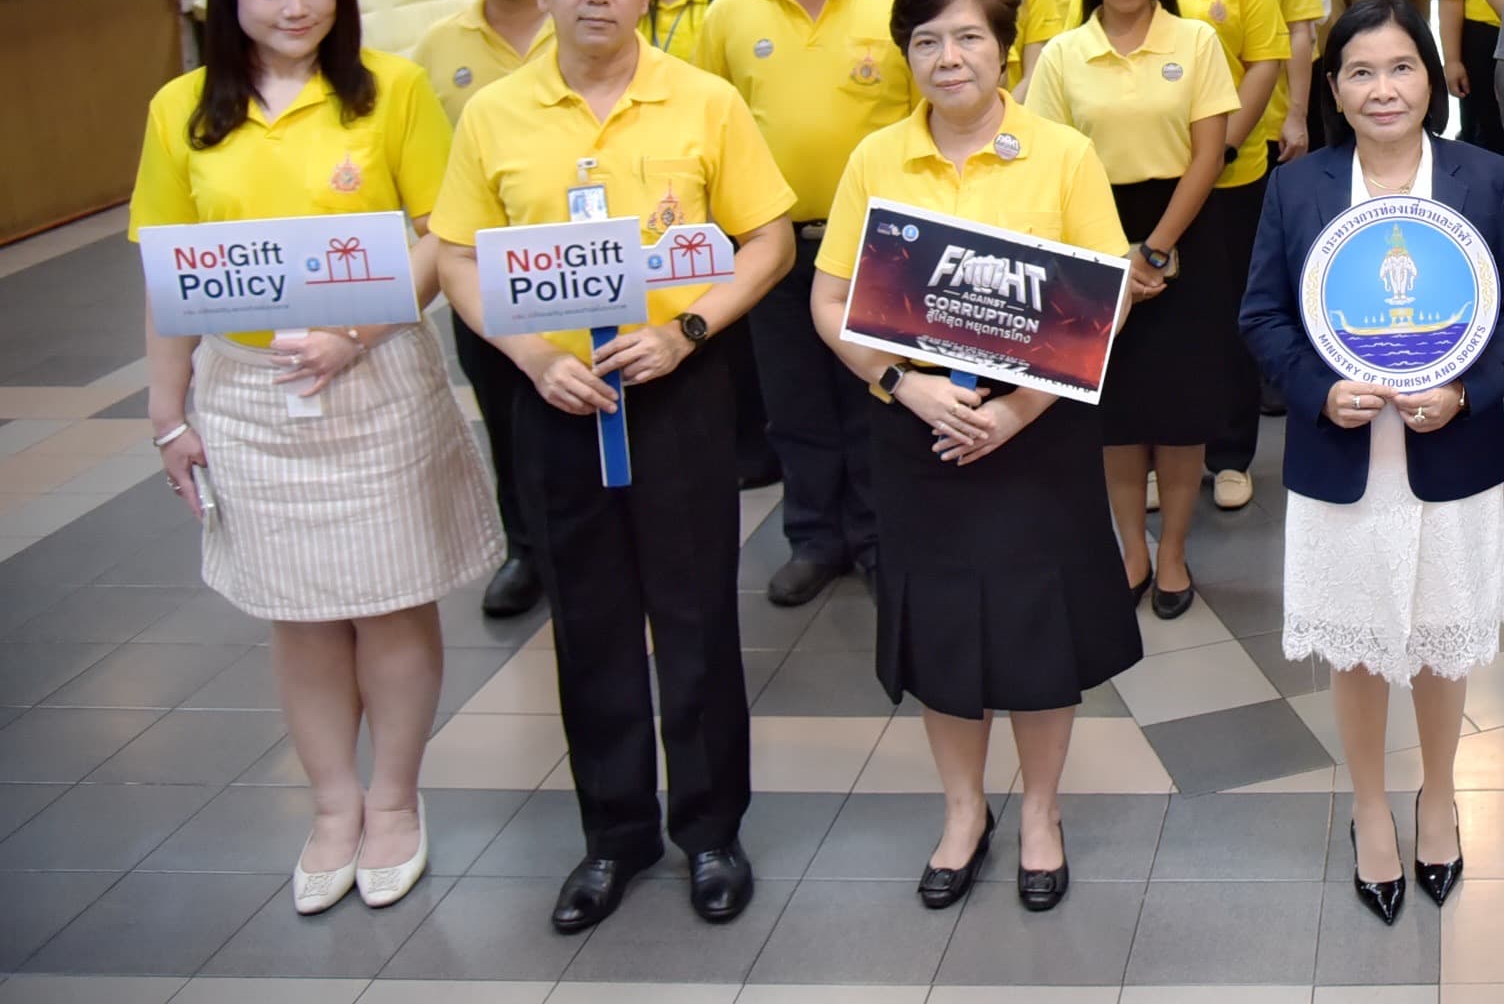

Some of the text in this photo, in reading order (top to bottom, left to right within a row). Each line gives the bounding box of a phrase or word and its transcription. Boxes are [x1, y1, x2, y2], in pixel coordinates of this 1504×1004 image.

[1321, 199, 1473, 255] กระทรวงการท่องเที่ยวและกีฬา
[178, 270, 286, 302] Policy
[509, 271, 625, 304] Policy
[961, 292, 1007, 309] AGAINST
[923, 293, 1040, 334] CORRUPTION
[926, 307, 1032, 344] สู้ให้สุด หยุดการโกง
[1318, 324, 1486, 388] MINISTRY OF TOURISM AND SPORTS
